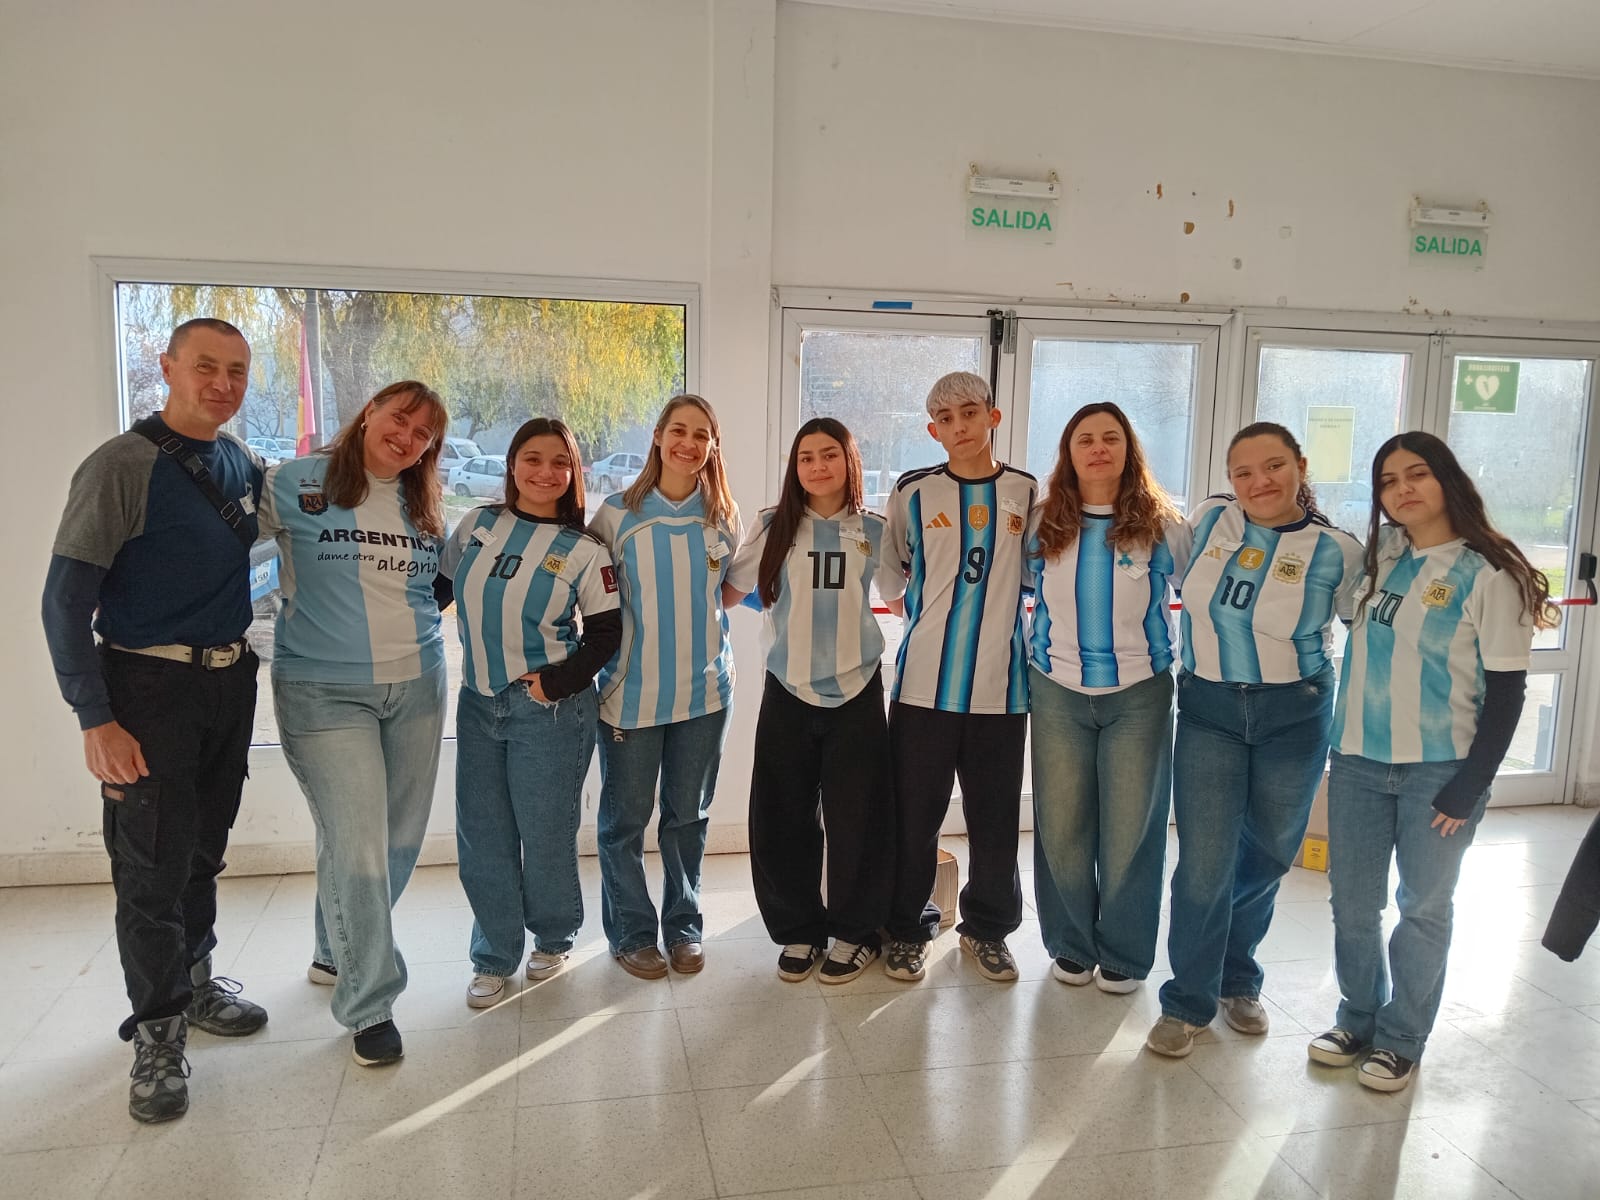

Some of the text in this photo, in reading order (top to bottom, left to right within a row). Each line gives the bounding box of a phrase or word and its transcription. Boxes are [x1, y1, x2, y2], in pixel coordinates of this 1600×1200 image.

[972, 207, 1051, 231] SALIDA
[1415, 235, 1482, 256] SALIDA
[317, 552, 350, 561] dame
[352, 553, 375, 561] otra
[489, 552, 523, 579] 10
[807, 551, 846, 589] 10
[1279, 564, 1297, 577] AFA
[1219, 575, 1256, 610] 10
[1430, 587, 1447, 601] AFA
[1371, 589, 1404, 627] 10
